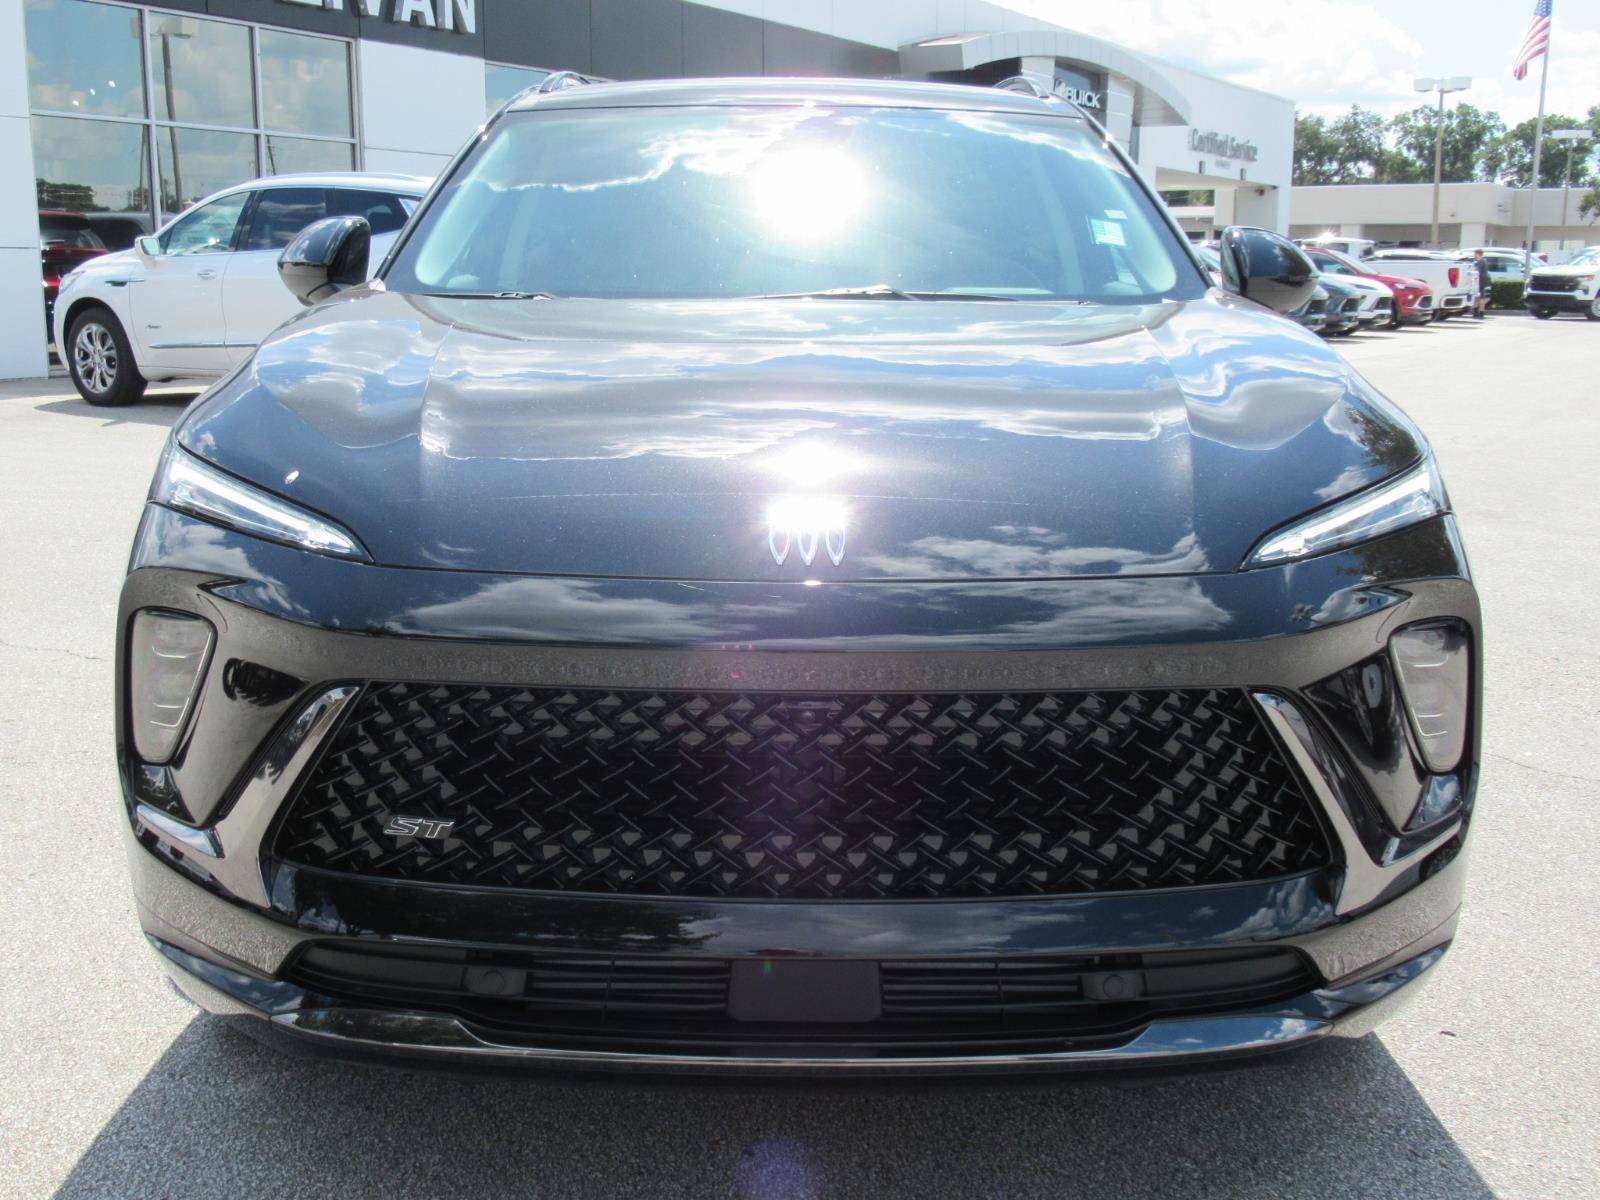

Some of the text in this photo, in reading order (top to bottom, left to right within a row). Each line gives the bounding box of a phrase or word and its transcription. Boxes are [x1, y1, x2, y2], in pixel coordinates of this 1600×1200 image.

[1067, 87, 1101, 109] BUICK
[1191, 129, 1258, 162] Certified Service
[383, 816, 455, 838] ST
